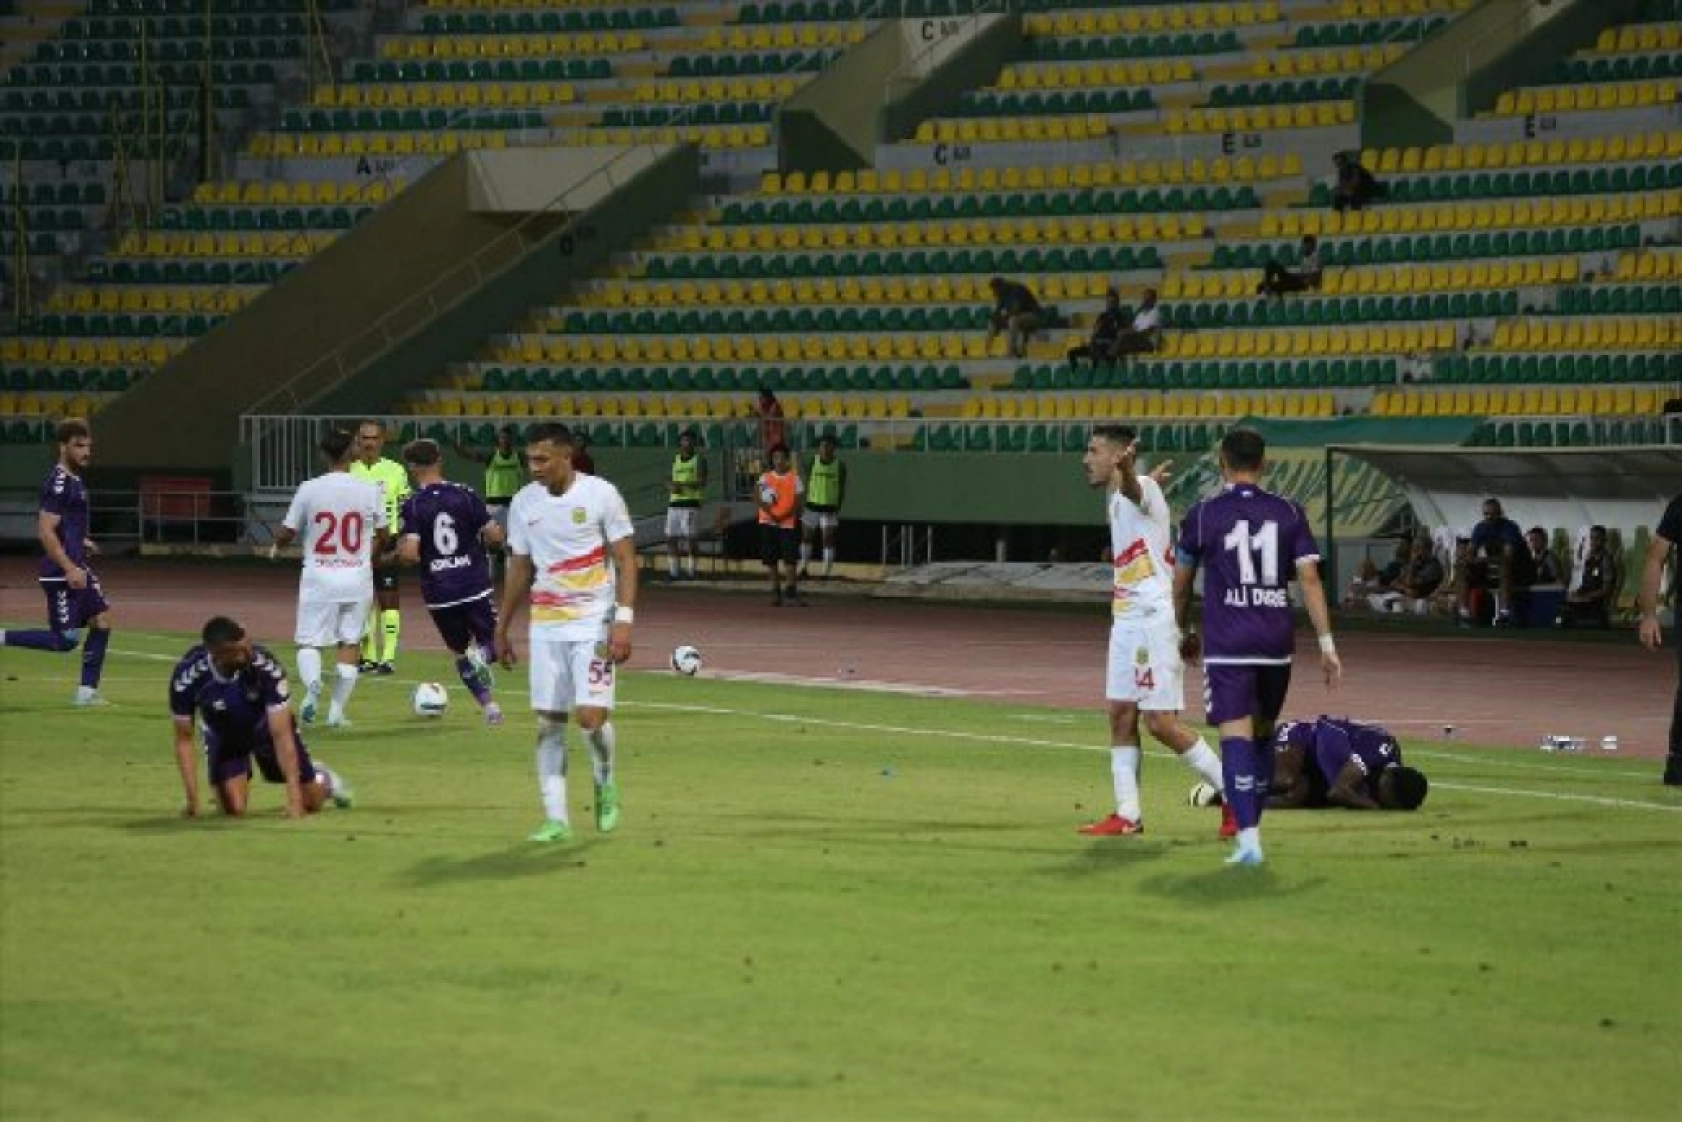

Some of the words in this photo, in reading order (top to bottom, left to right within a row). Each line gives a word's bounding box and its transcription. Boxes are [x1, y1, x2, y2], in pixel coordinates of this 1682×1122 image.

[923, 20, 934, 40] C
[1525, 115, 1536, 139] E
[935, 143, 947, 165] C
[1222, 133, 1236, 154] E
[357, 154, 371, 174] A
[314, 510, 364, 555] 20
[433, 511, 458, 555] 6
[1223, 519, 1279, 586] 11
[588, 660, 613, 686] 55
